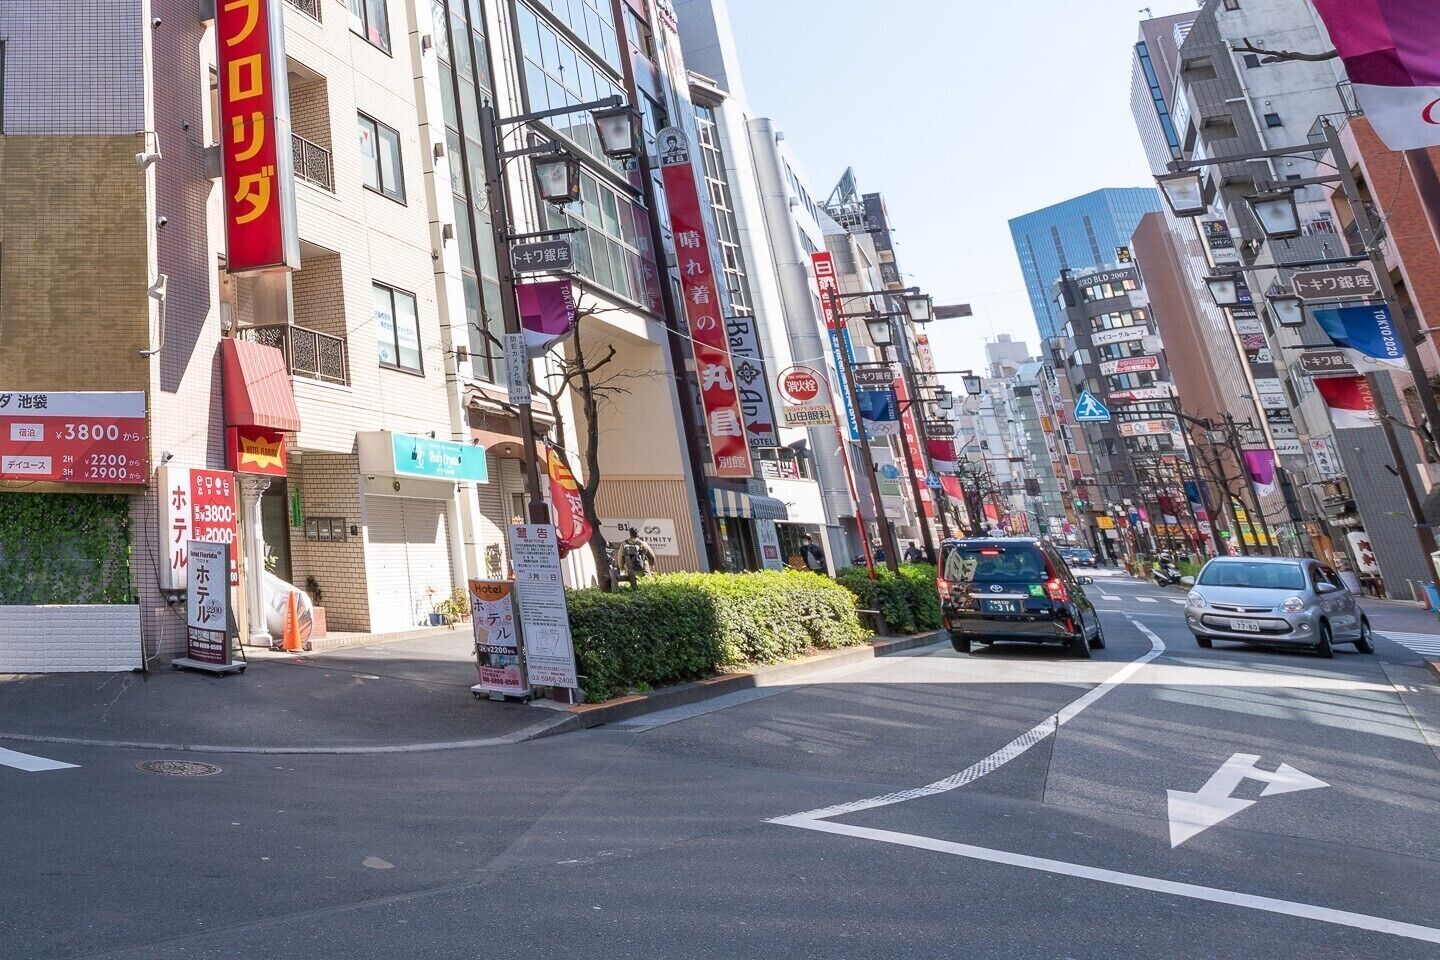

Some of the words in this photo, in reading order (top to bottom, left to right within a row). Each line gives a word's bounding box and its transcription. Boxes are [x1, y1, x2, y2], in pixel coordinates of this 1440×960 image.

[513, 246, 570, 266] トキワ銀座
[677, 230, 717, 331] 晴れ着の
[1295, 273, 1373, 293] トキワ銀座
[560, 285, 575, 311] TOKYO
[1373, 309, 1388, 339] TOKYO
[1382, 336, 1399, 357] 2020
[854, 369, 893, 383] トキワ銀座
[786, 379, 818, 393] 消火栓
[18, 394, 48, 410] 池袋
[701, 363, 743, 438] 丸昌
[784, 411, 831, 422] 山田眼科
[18, 427, 36, 438] 宿泊
[7, 460, 47, 470] デイユース
[62, 455, 74, 463] 2H
[718, 456, 746, 469] 別館
[62, 468, 74, 476] 3H
[171, 485, 188, 570] ホテル
[617, 523, 629, 531] B1
[196, 565, 211, 624] ホテル
[474, 583, 502, 594] Hotel
[206, 606, 222, 615] 2200
[473, 599, 512, 641] ホテル
